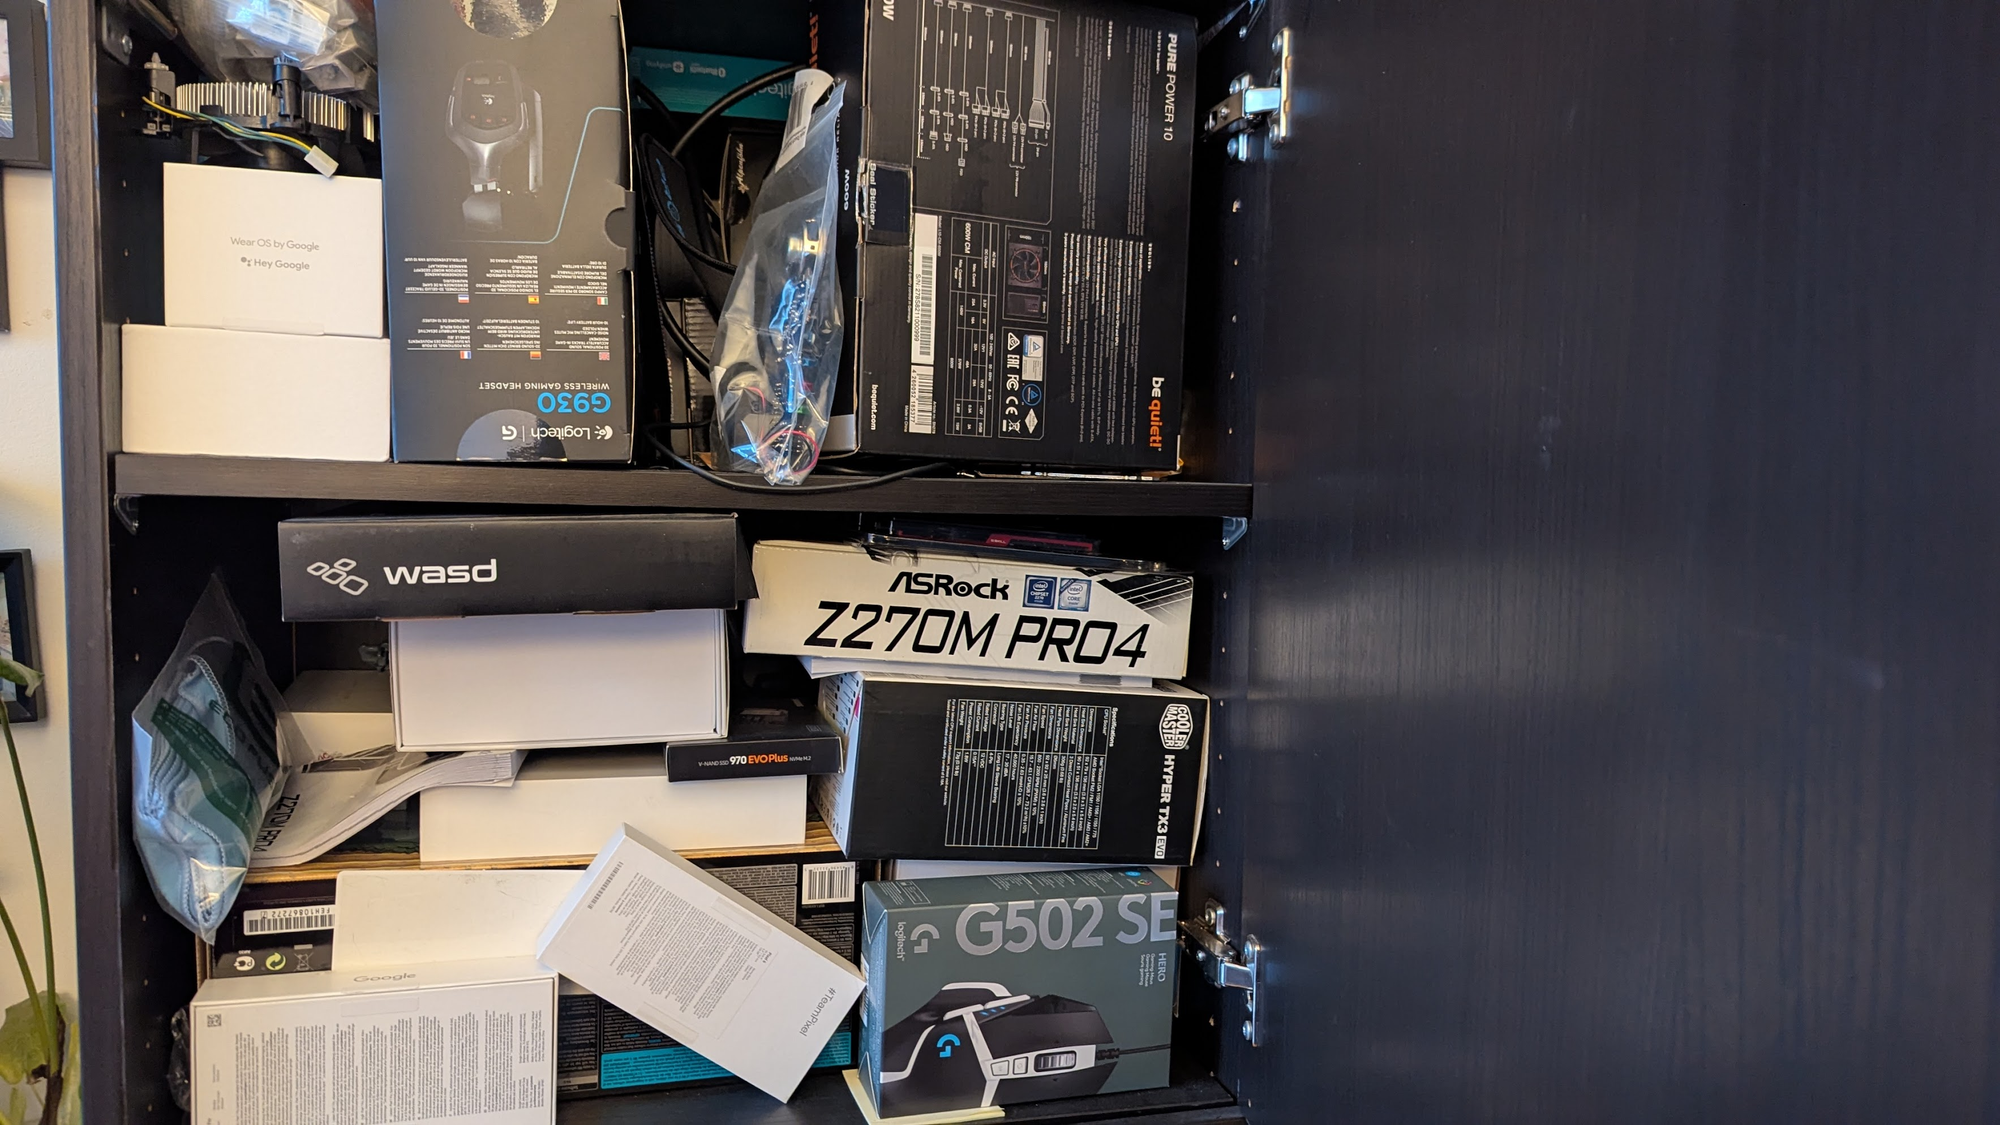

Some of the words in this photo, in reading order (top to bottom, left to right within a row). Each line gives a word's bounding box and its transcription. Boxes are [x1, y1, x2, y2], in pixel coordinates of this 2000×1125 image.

[1165, 33, 1179, 72] PURE
[1163, 74, 1177, 123] POWER
[1162, 125, 1175, 142] 10
[869, 163, 877, 185] Seal
[843, 169, 851, 211] 600W
[869, 187, 877, 226] Sticker
[230, 236, 256, 248] Wear
[258, 238, 271, 249] OS
[272, 240, 285, 252] by
[286, 240, 320, 254] Google
[253, 258, 273, 271] Hey
[275, 259, 310, 273] Google
[479, 382, 522, 390] HEADSET
[524, 382, 562, 390] GAMING
[1151, 377, 1164, 397] be
[536, 392, 612, 414] G930
[869, 384, 879, 431] bequiet.com
[530, 425, 591, 440] Logitech
[1148, 400, 1162, 448] quiet!
[383, 558, 498, 585] wasd
[887, 571, 1010, 601] ASRock
[804, 601, 1001, 658] Z270M
[1005, 615, 1148, 667] PRO4
[1108, 707, 1118, 746] Specifications
[1162, 706, 1180, 747] MASTER
[1174, 706, 1192, 748] COOLER
[730, 756, 747, 764] 970
[748, 755, 768, 764] EVO
[768, 753, 788, 763] Plus
[1159, 754, 1176, 803] HYPER
[1156, 806, 1169, 834] TX3
[1156, 838, 1165, 857] EVO
[955, 896, 1104, 956] G502
[1115, 892, 1177, 945] SE
[895, 922, 907, 959] logitech
[354, 973, 416, 983] Google
[1157, 952, 1167, 982] HERO
[799, 986, 838, 1040] #TeamPixel
